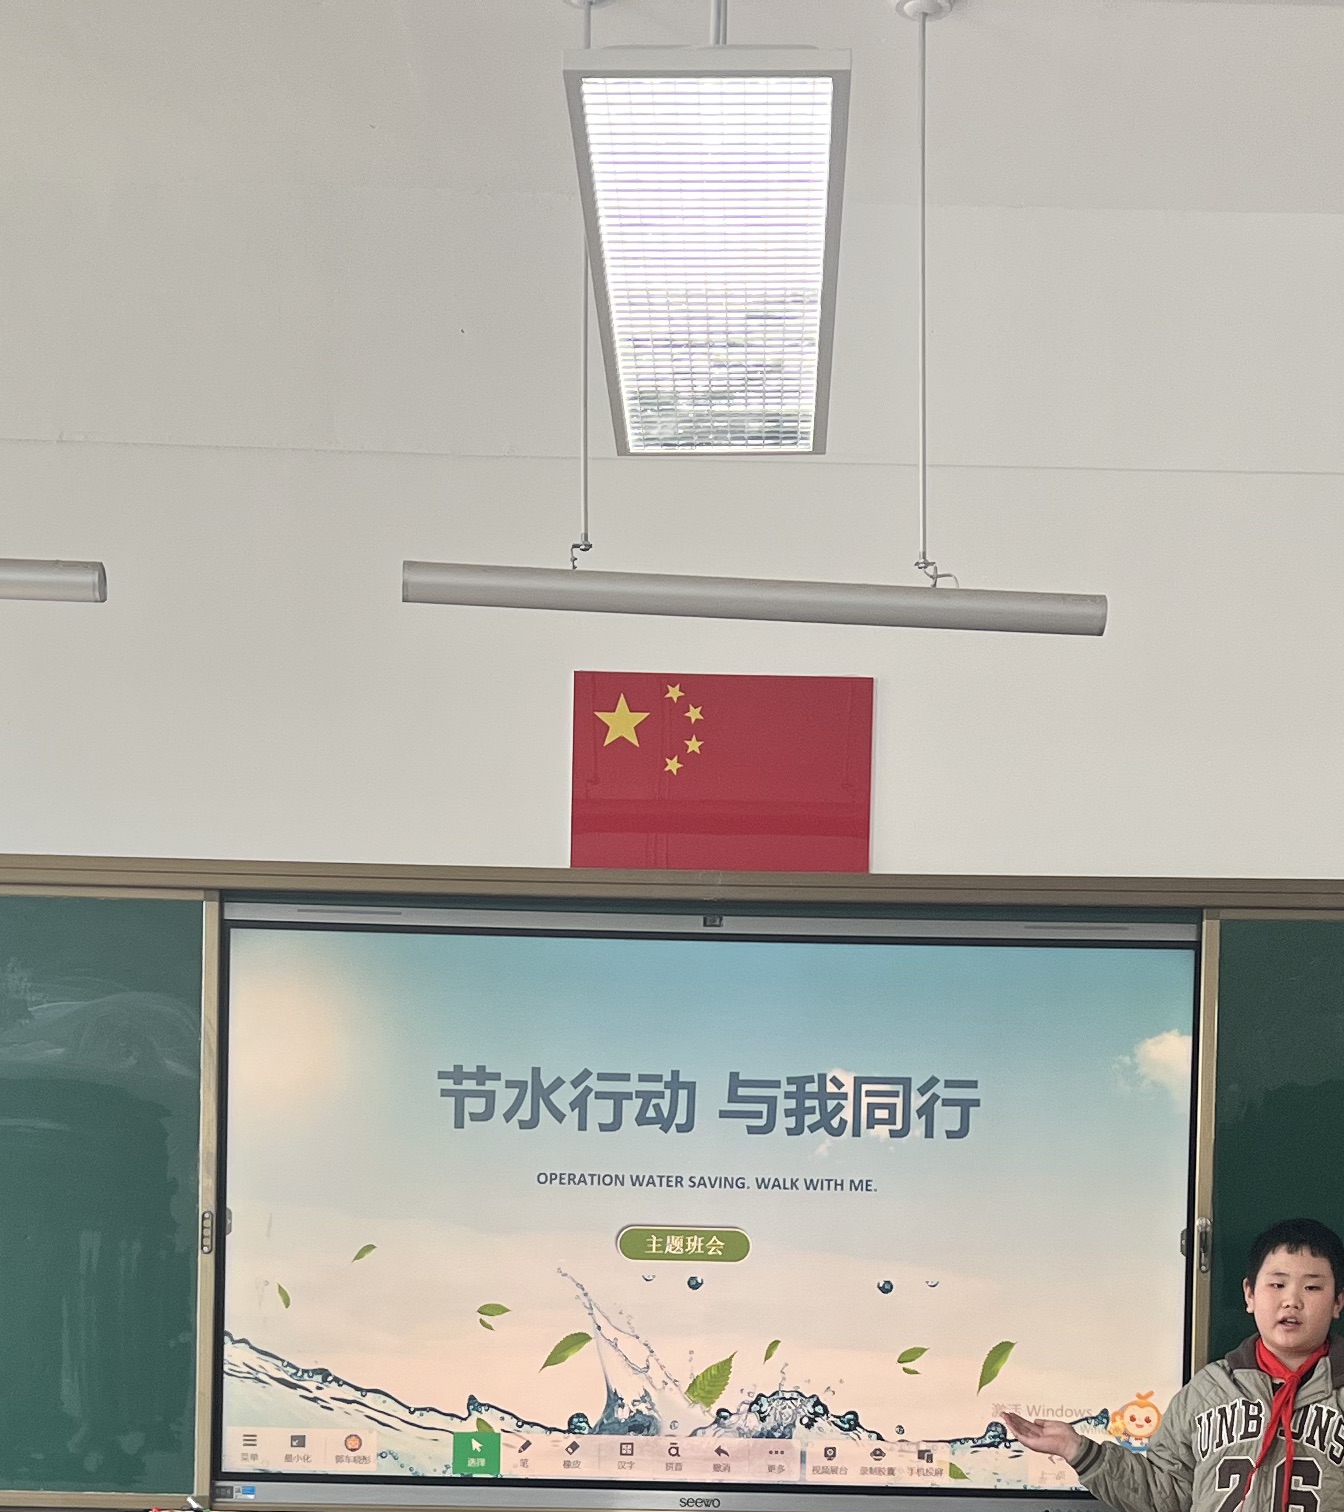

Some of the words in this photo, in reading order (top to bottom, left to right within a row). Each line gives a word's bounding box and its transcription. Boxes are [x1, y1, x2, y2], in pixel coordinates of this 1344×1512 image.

[437, 1064, 697, 1134] 节水行动
[718, 1071, 982, 1140] 与我同行
[536, 1172, 625, 1187] OPERATION
[630, 1174, 684, 1188] WATER
[688, 1175, 751, 1190] SAVING.
[755, 1177, 799, 1191] WALK
[804, 1178, 844, 1192] WITH
[848, 1178, 878, 1192] ME.
[644, 1234, 725, 1256] 主题班会
[1026, 1404, 1093, 1418] Windows
[284, 1454, 312, 1463] 最小化
[467, 1457, 486, 1467] 选择
[563, 1459, 581, 1470] 橡皮
[617, 1460, 636, 1471] 汉字
[665, 1461, 683, 1472] 拼音
[767, 1464, 786, 1474] 更多
[679, 1497, 721, 1508] seewo
